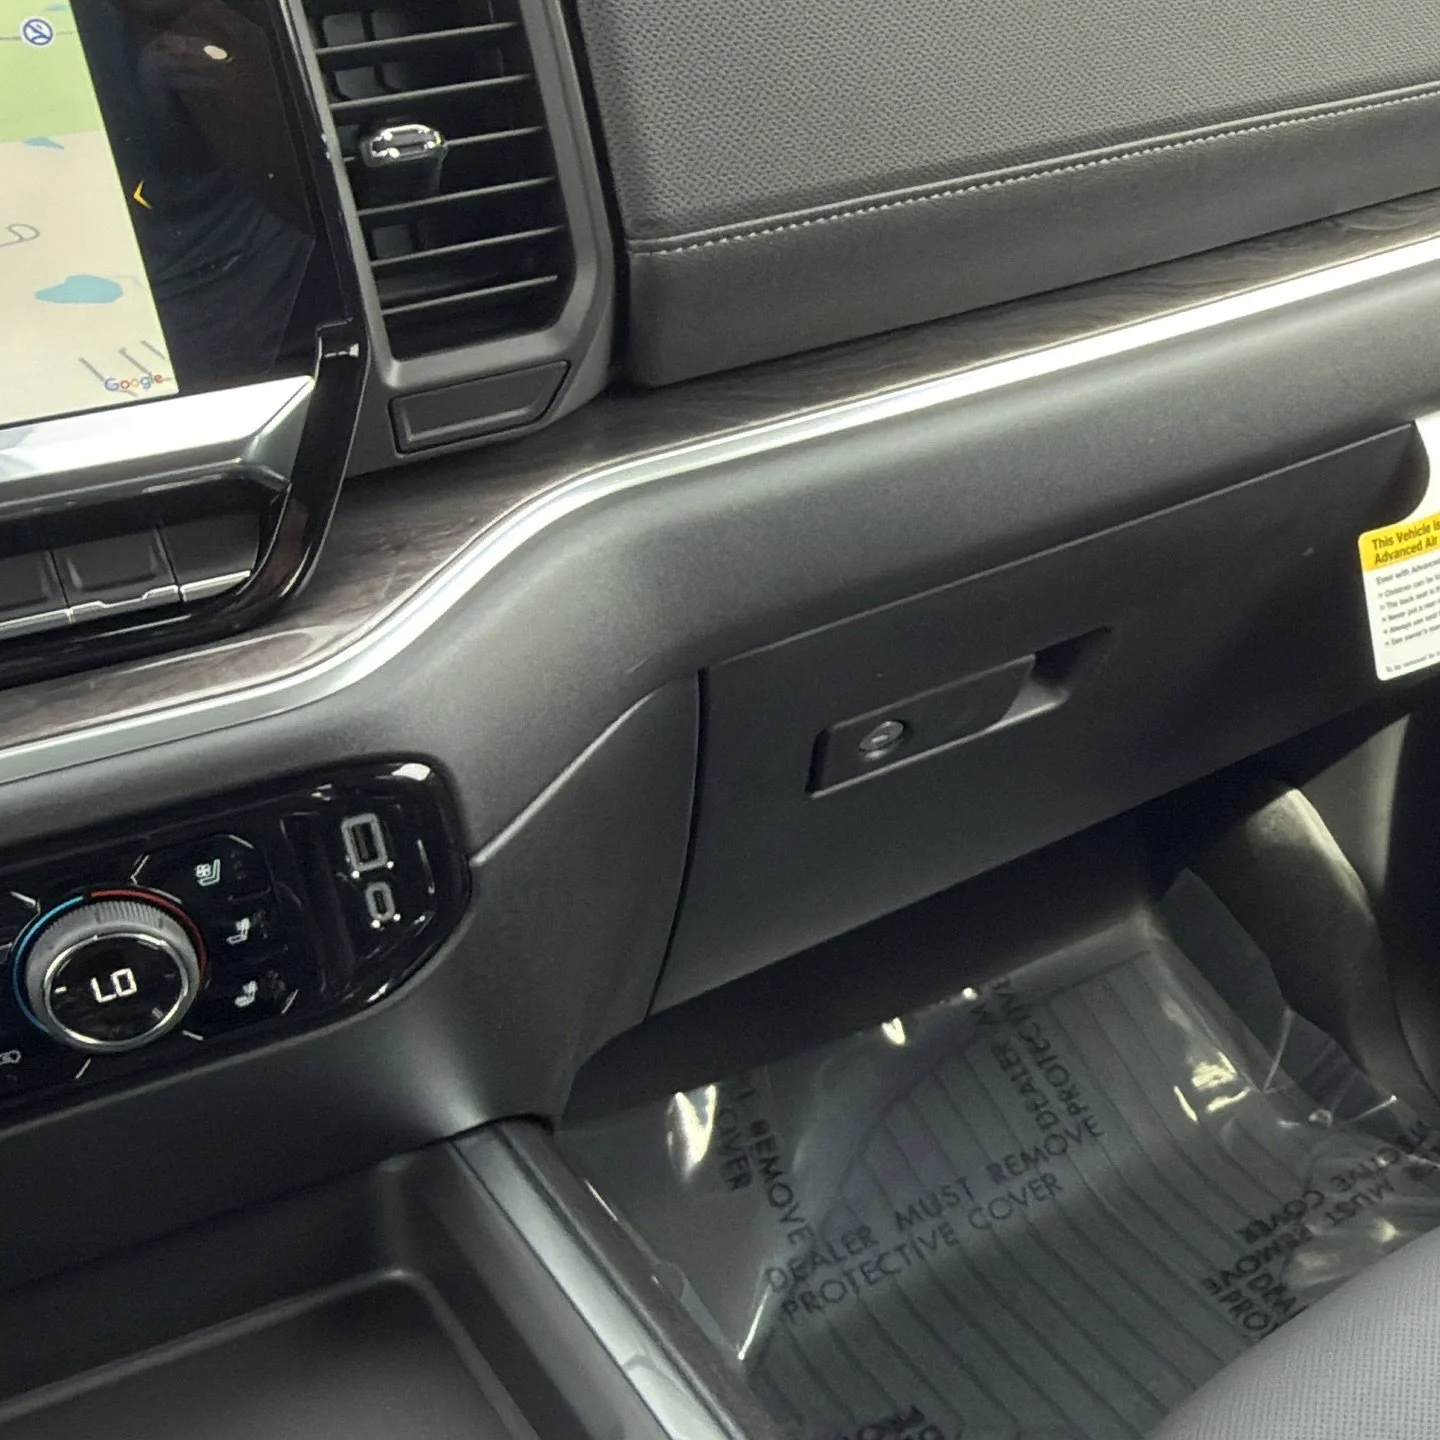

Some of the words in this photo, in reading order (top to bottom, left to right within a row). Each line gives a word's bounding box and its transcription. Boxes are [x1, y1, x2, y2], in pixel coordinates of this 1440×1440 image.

[104, 372, 163, 392] Google
[1371, 536, 1395, 552] This
[1396, 523, 1431, 542] Vehicle
[1374, 542, 1423, 566] Advanced
[1425, 534, 1438, 549] Air
[763, 1223, 880, 1293] DEALER
[894, 1175, 975, 1232] MUST
[984, 1114, 1104, 1187] REMOVE
[780, 1220, 961, 1324] PROTECTIVE
[967, 1170, 1066, 1233] COVER
